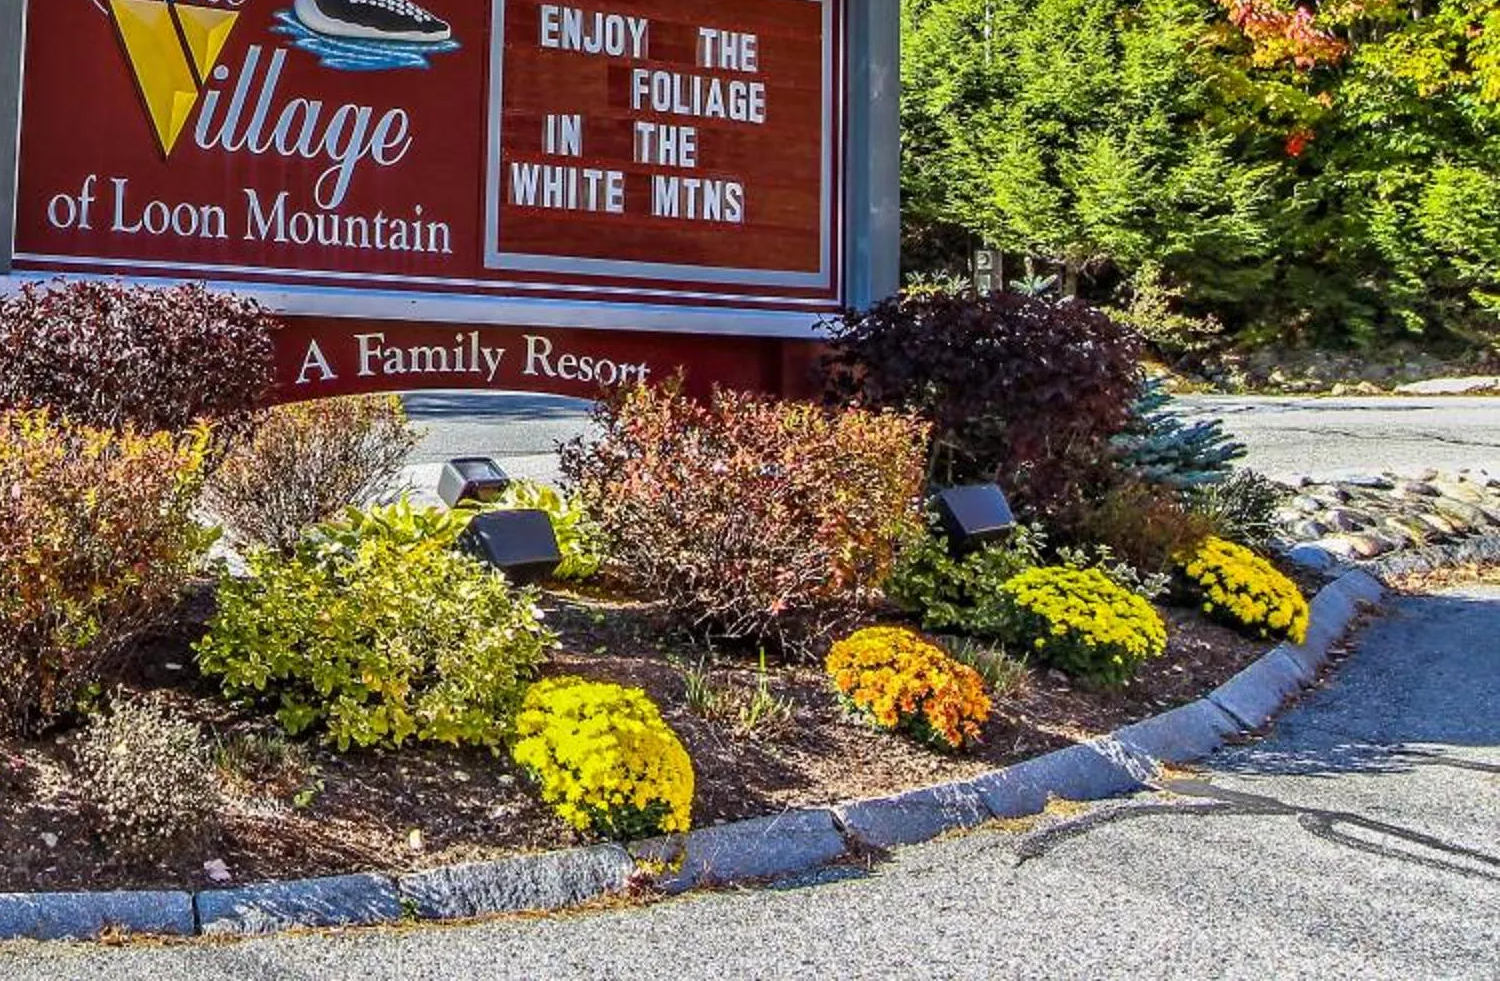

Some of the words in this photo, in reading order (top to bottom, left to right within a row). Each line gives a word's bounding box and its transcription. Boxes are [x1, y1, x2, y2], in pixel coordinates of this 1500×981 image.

[540, 5, 648, 58] ENJOY
[698, 26, 758, 73] THE
[631, 68, 766, 124] FOLIAGE
[545, 114, 582, 156] IN
[635, 121, 697, 167] THE
[47, 174, 97, 230] of
[110, 178, 228, 239] Loon
[243, 187, 453, 254] Mountain
[510, 162, 624, 213] WHITE
[652, 175, 744, 223] MTNS
[295, 339, 339, 384] A
[353, 331, 506, 382] Family
[522, 334, 652, 386] Resort
